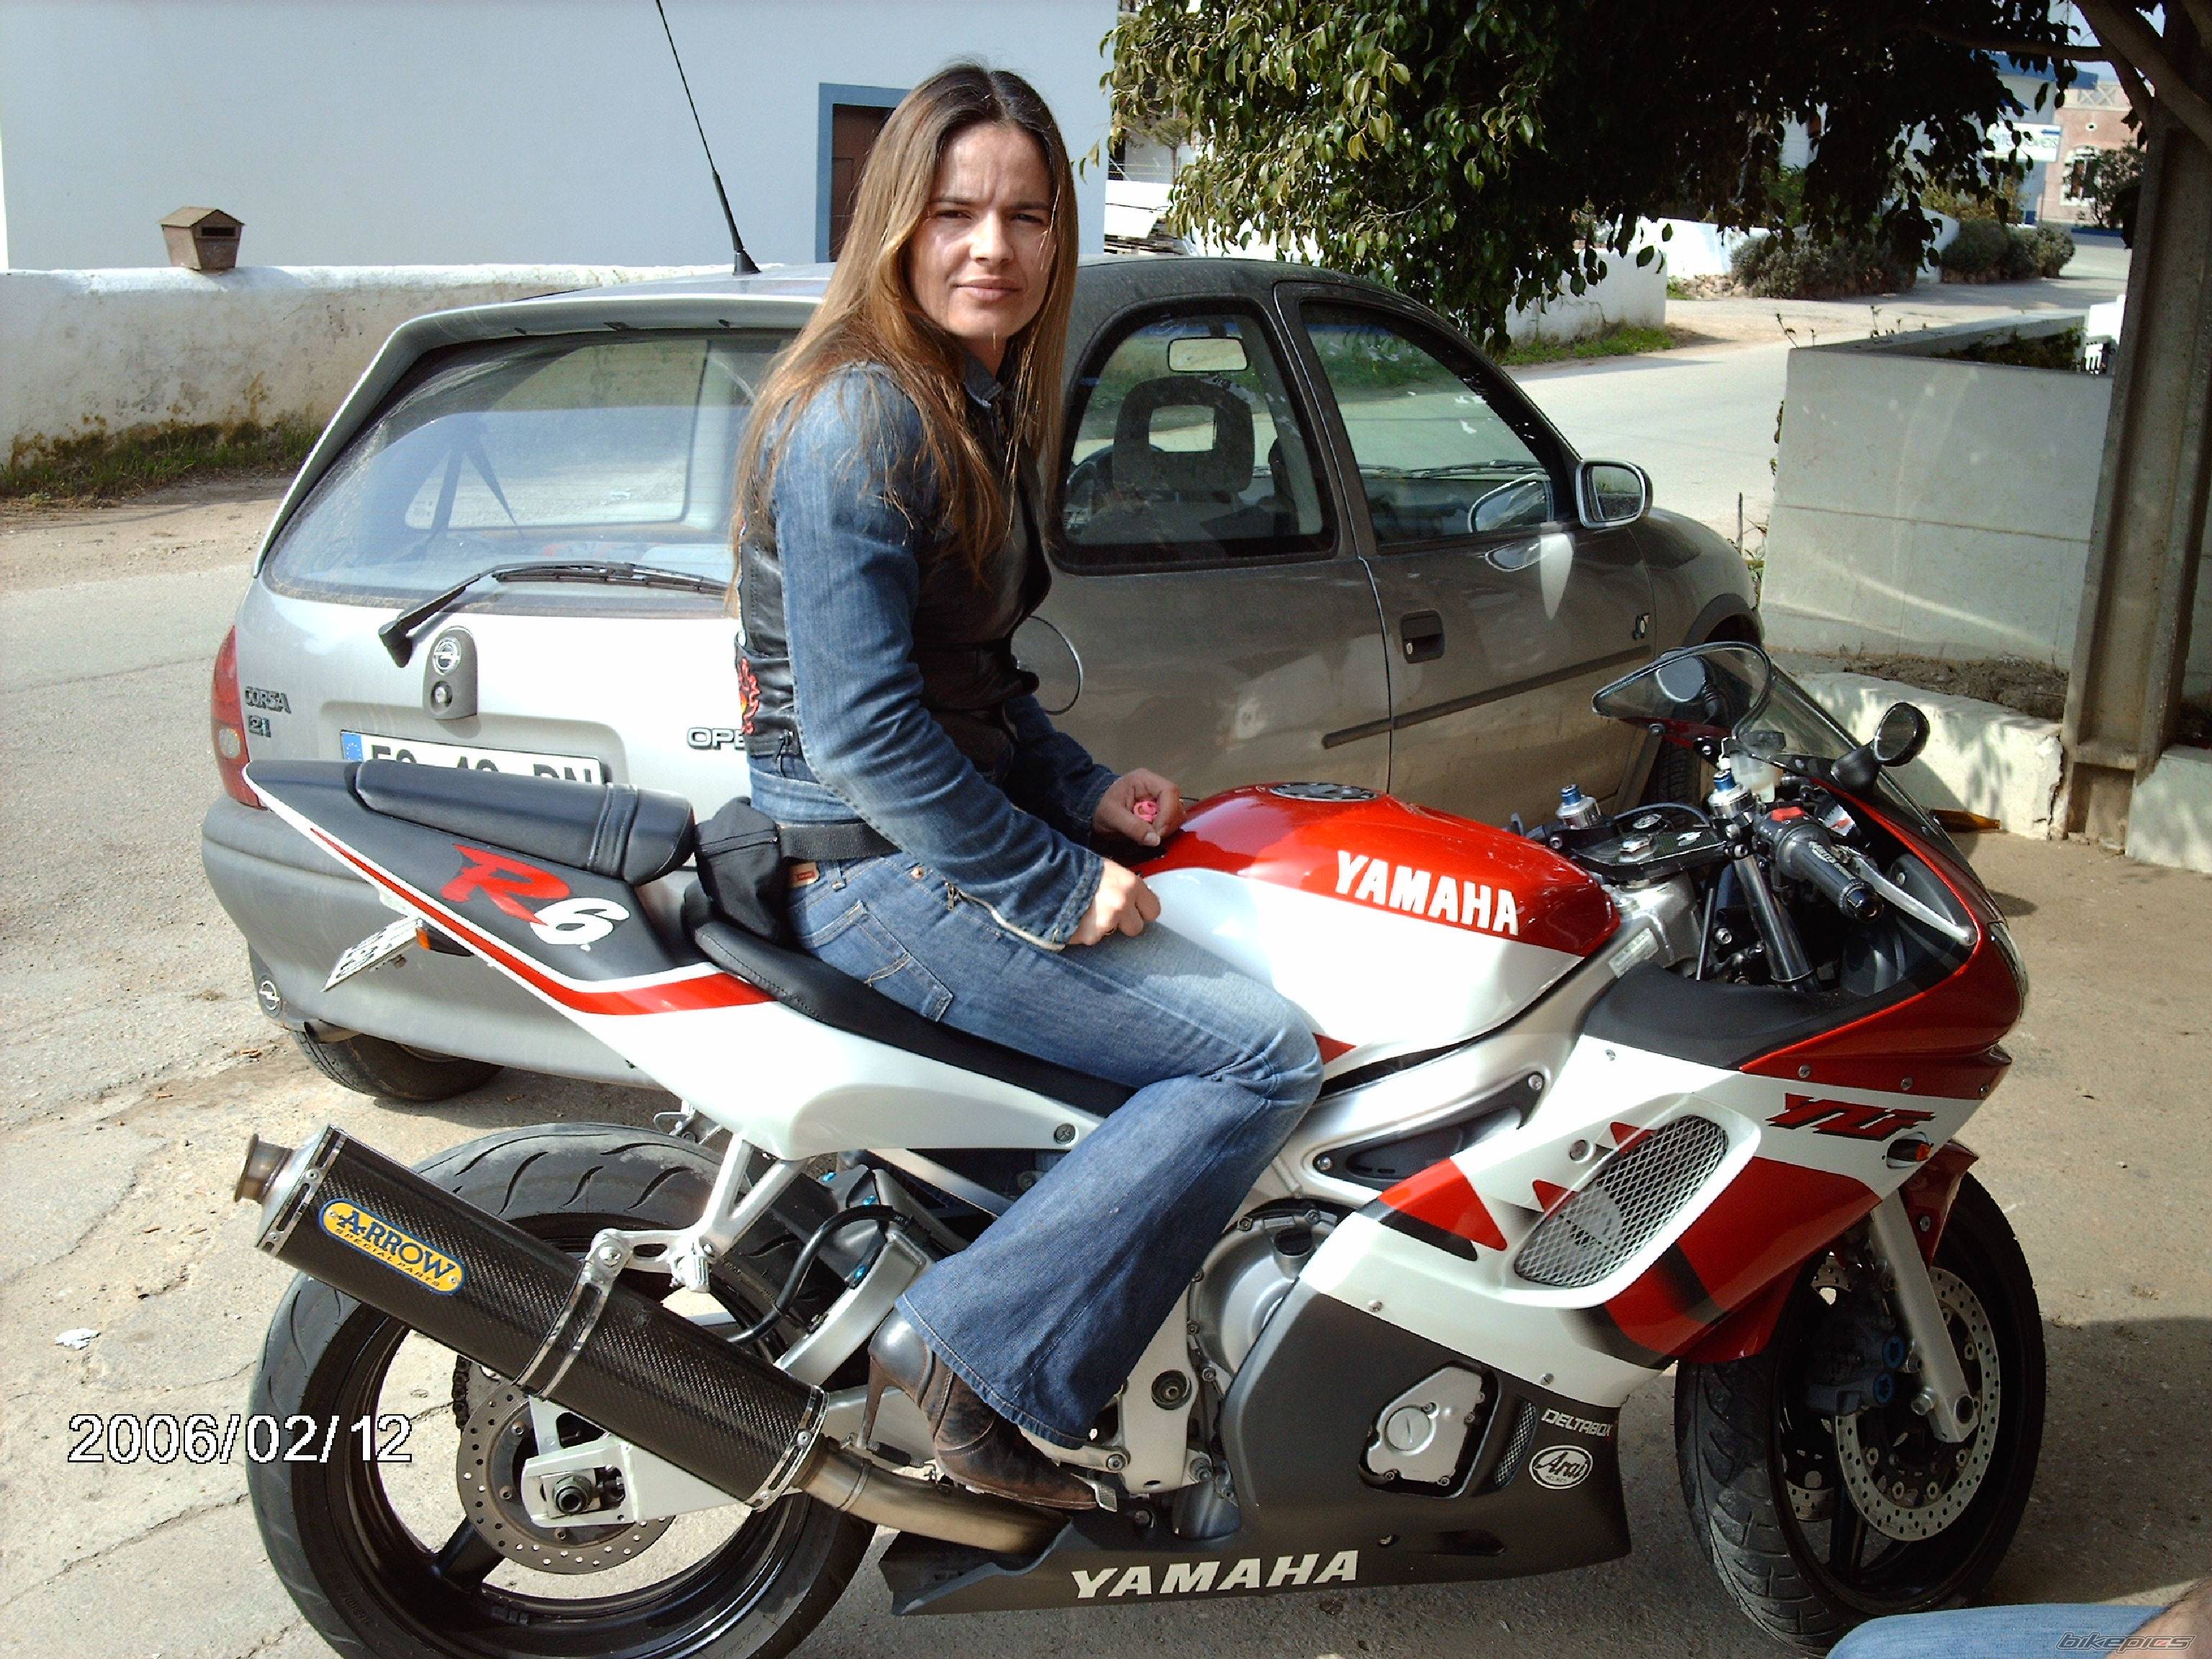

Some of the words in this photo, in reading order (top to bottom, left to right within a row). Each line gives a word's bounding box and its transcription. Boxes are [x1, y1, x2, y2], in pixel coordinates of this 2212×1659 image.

[245, 685, 292, 714] CORSA
[688, 727, 745, 750] OPE
[440, 843, 630, 951] R6
[1336, 850, 1519, 935] YAMAHA
[1765, 1092, 1936, 1141] YZF
[337, 1210, 455, 1279] ARROW
[1541, 1408, 1613, 1437] DELTABOX
[1533, 1452, 1588, 1478] Arai
[1071, 1550, 1359, 1599] YAMAHA
